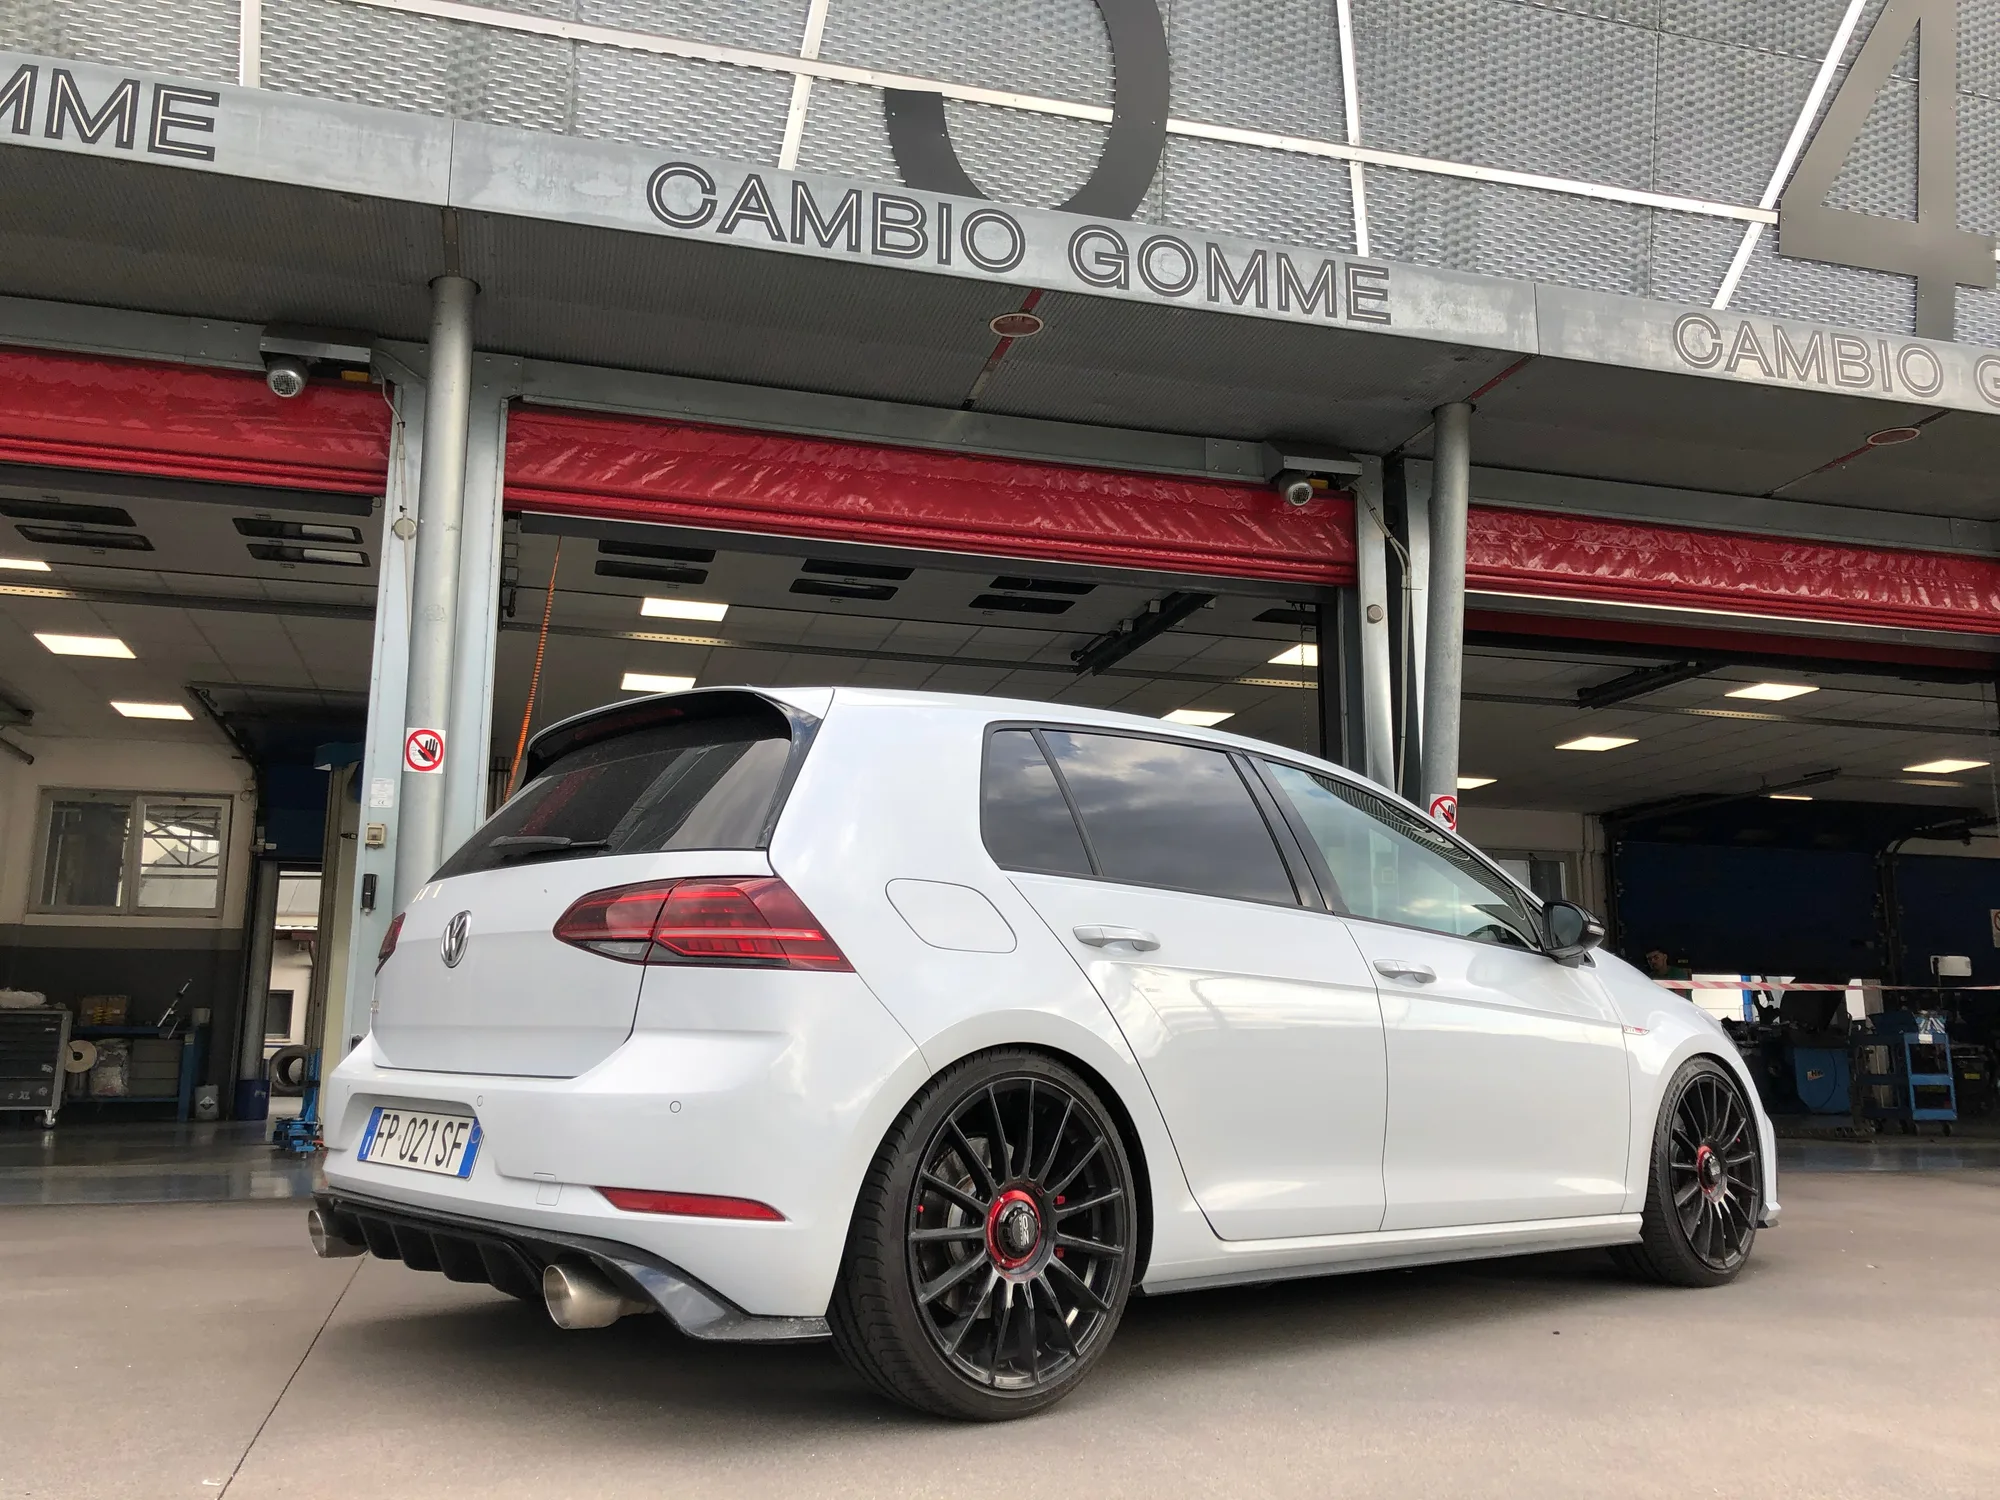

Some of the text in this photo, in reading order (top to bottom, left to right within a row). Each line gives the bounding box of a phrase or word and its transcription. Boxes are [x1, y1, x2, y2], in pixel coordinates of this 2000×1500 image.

[646, 161, 1392, 326] CAMBIO GOMME
[1779, 0, 1997, 342] 4
[1672, 312, 1944, 398] CAMBIO
